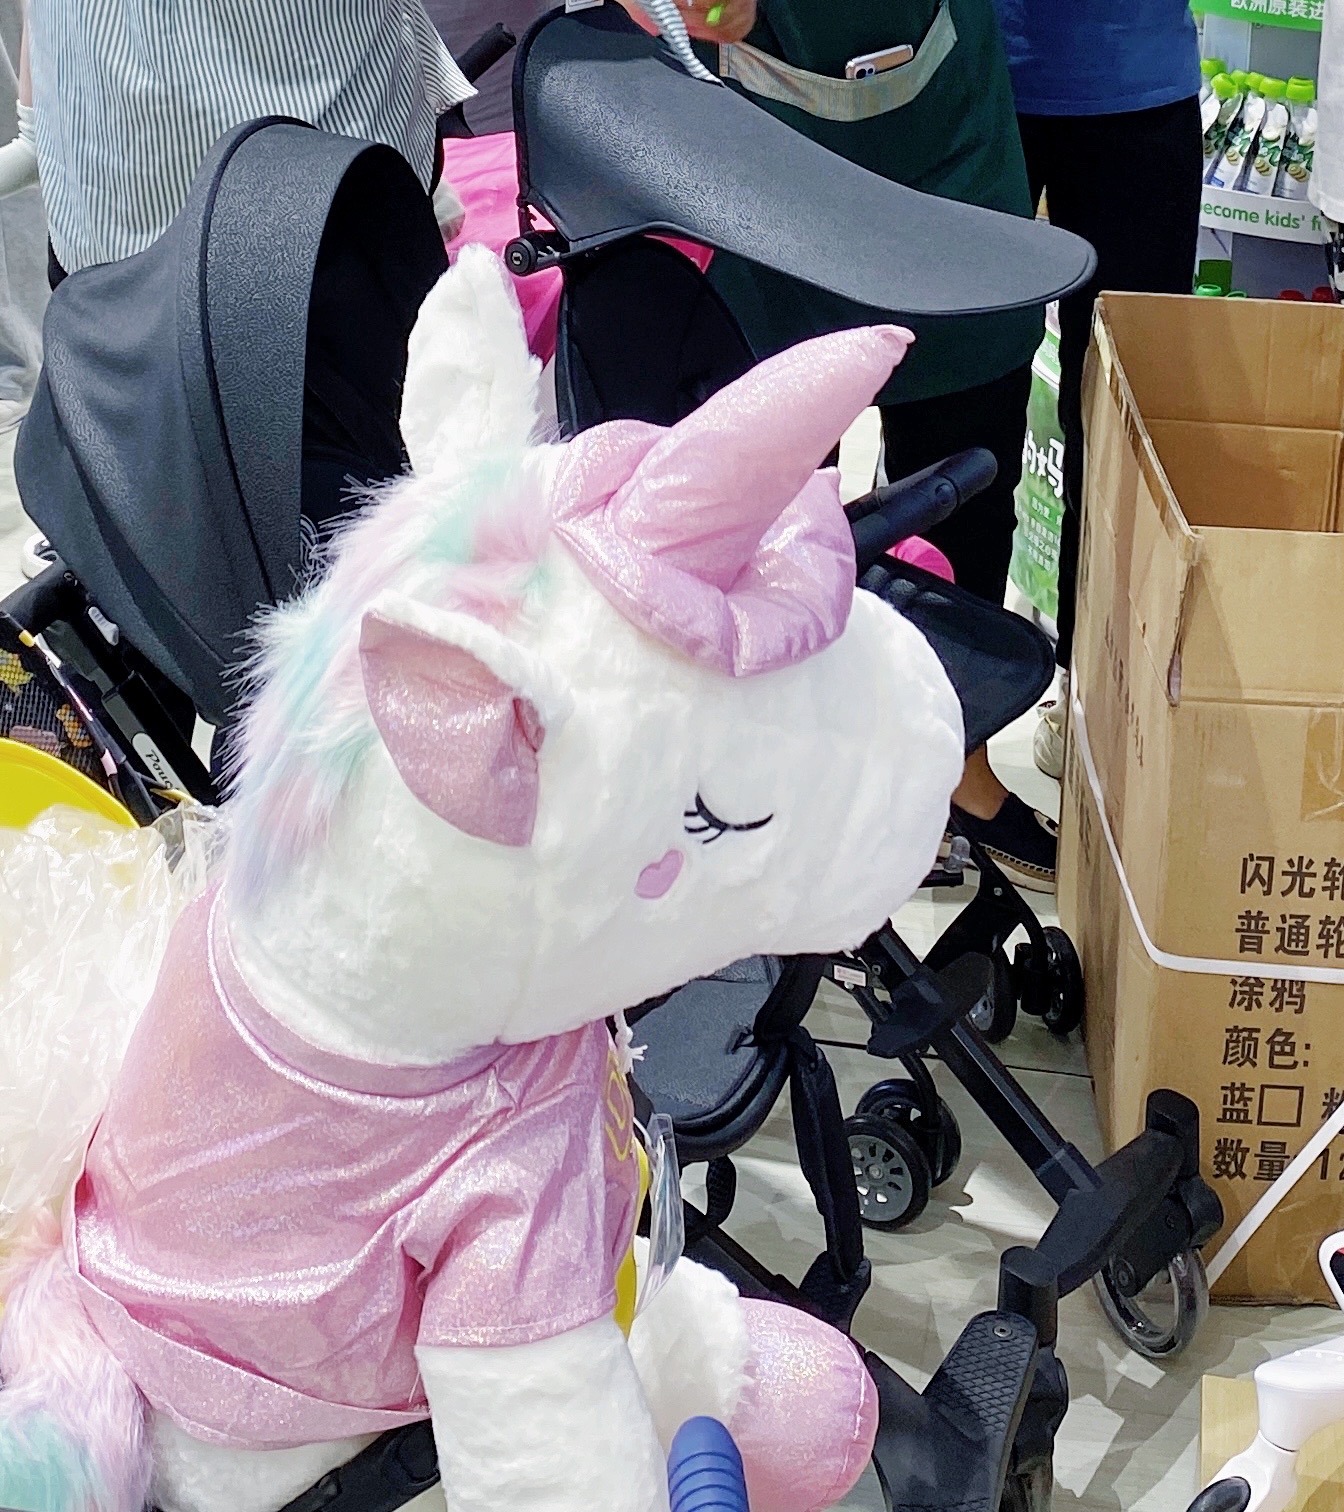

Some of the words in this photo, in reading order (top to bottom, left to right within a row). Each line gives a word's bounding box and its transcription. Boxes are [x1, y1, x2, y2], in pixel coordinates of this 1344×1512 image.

[1200, 202, 1259, 224] ecome
[1265, 209, 1306, 229] kids'
[145, 749, 174, 789] Pouc
[1228, 976, 1306, 1014] 涂鸦
[1216, 1082, 1255, 1124] 蓝
